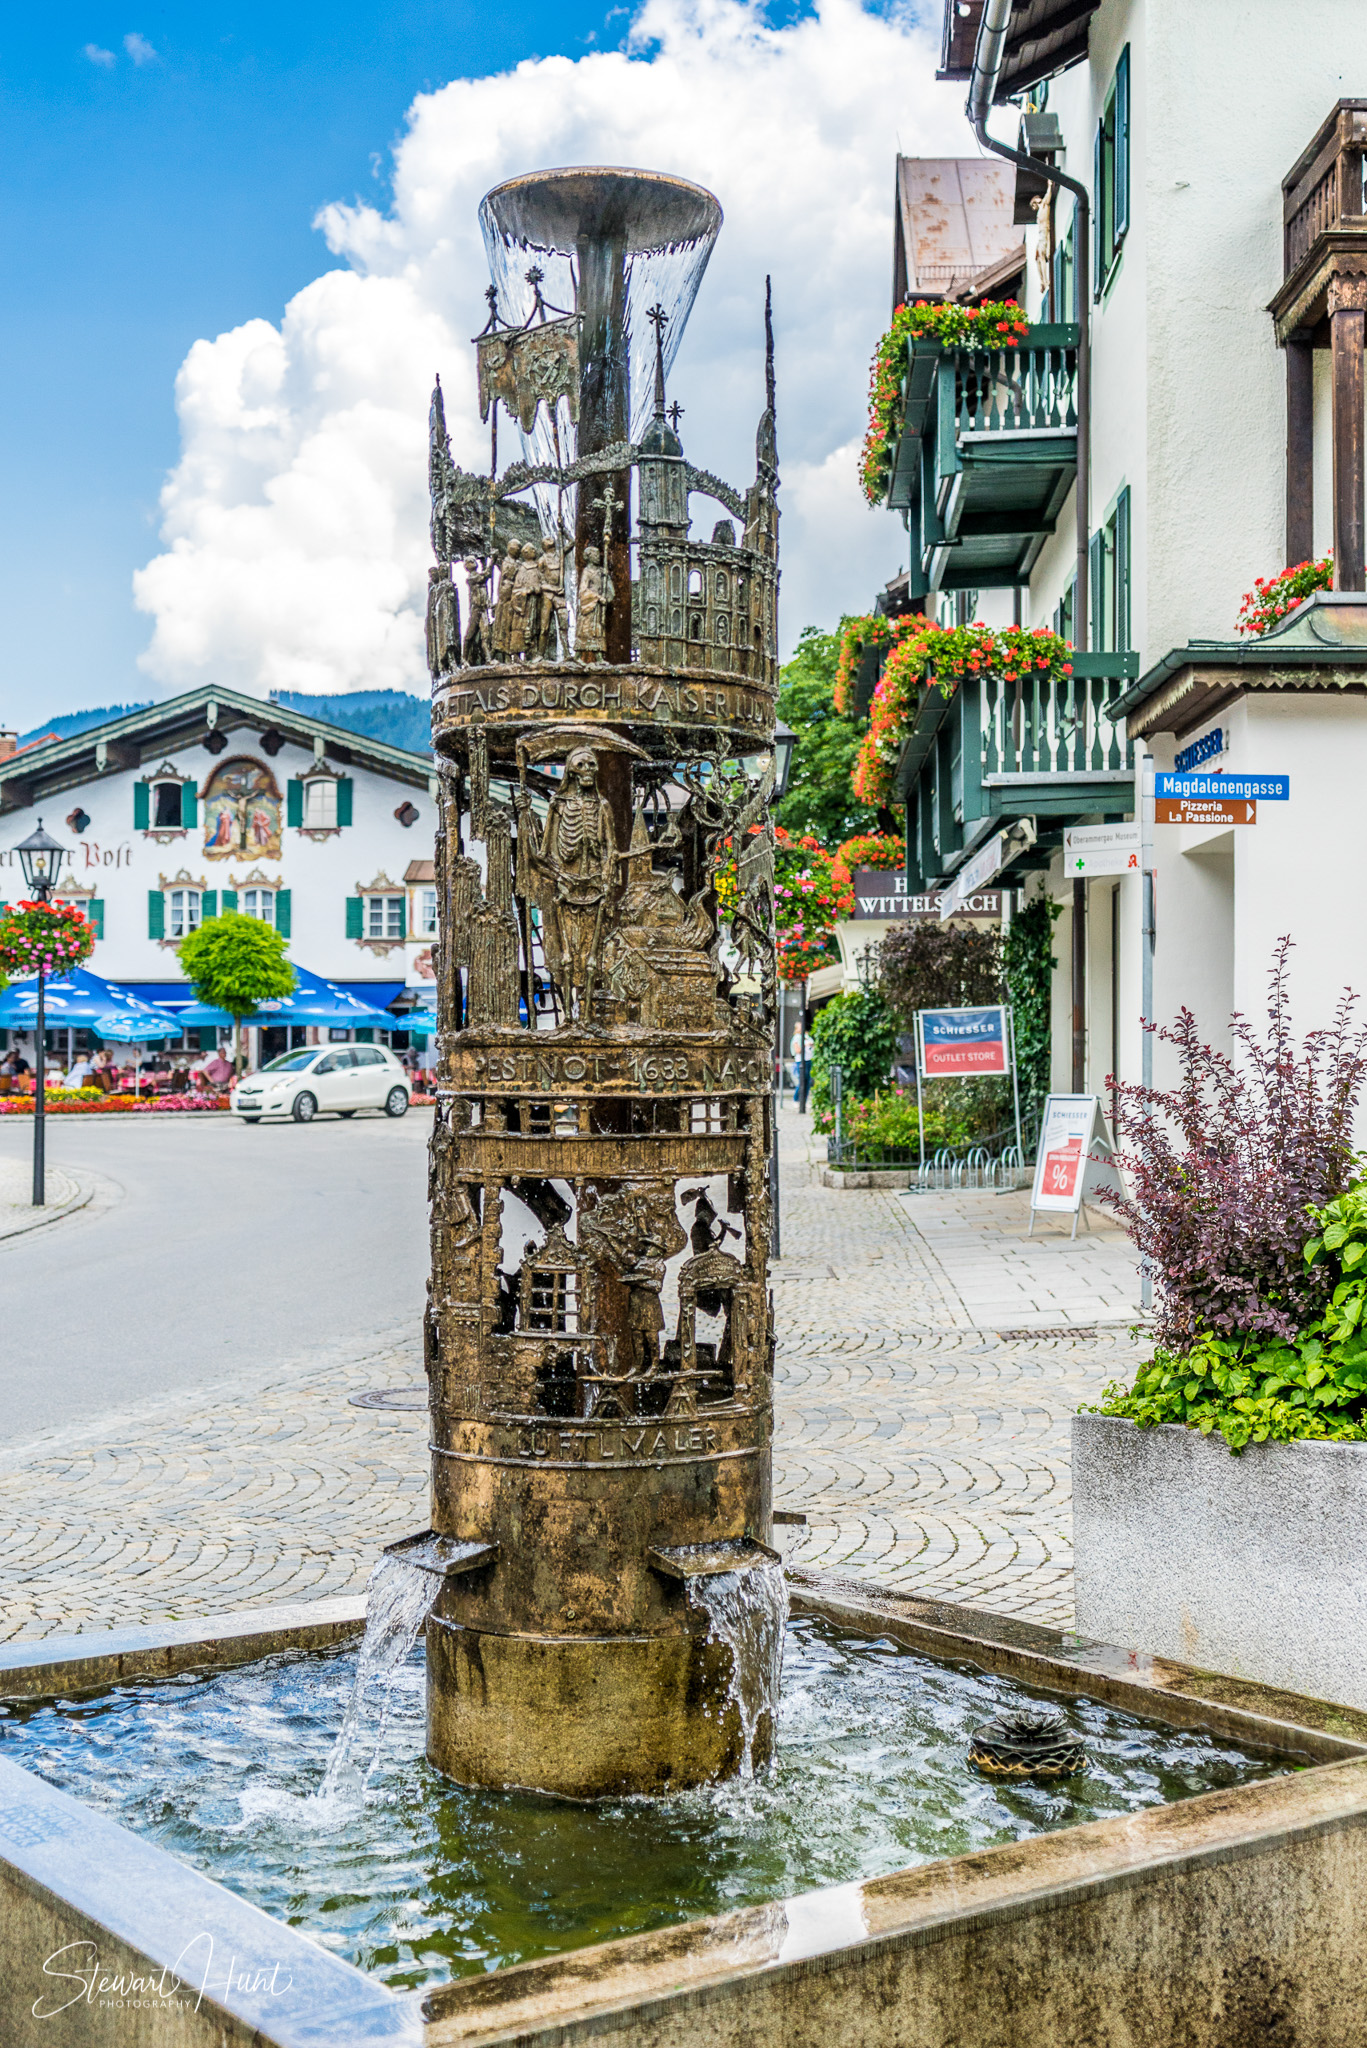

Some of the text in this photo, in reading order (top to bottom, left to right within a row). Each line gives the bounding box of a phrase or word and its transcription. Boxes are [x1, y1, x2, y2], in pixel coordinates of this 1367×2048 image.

[521, 682, 621, 710] DURCH
[634, 681, 731, 719] KAISER
[1174, 727, 1223, 774] SCHIESSER
[1162, 776, 1283, 798] Magdalenengasse
[1180, 800, 1223, 812] Pizzeria
[1168, 811, 1234, 823] La Passione
[1115, 832, 1138, 841] Museum
[857, 894, 999, 914] WITTELSACH
[932, 1023, 995, 1035] SCHIESSER
[932, 1051, 996, 1063] OUTLET STORE
[627, 1056, 690, 1082] 1633
[1052, 1111, 1088, 1119] SCHIESSER
[1052, 1164, 1068, 1190] %
